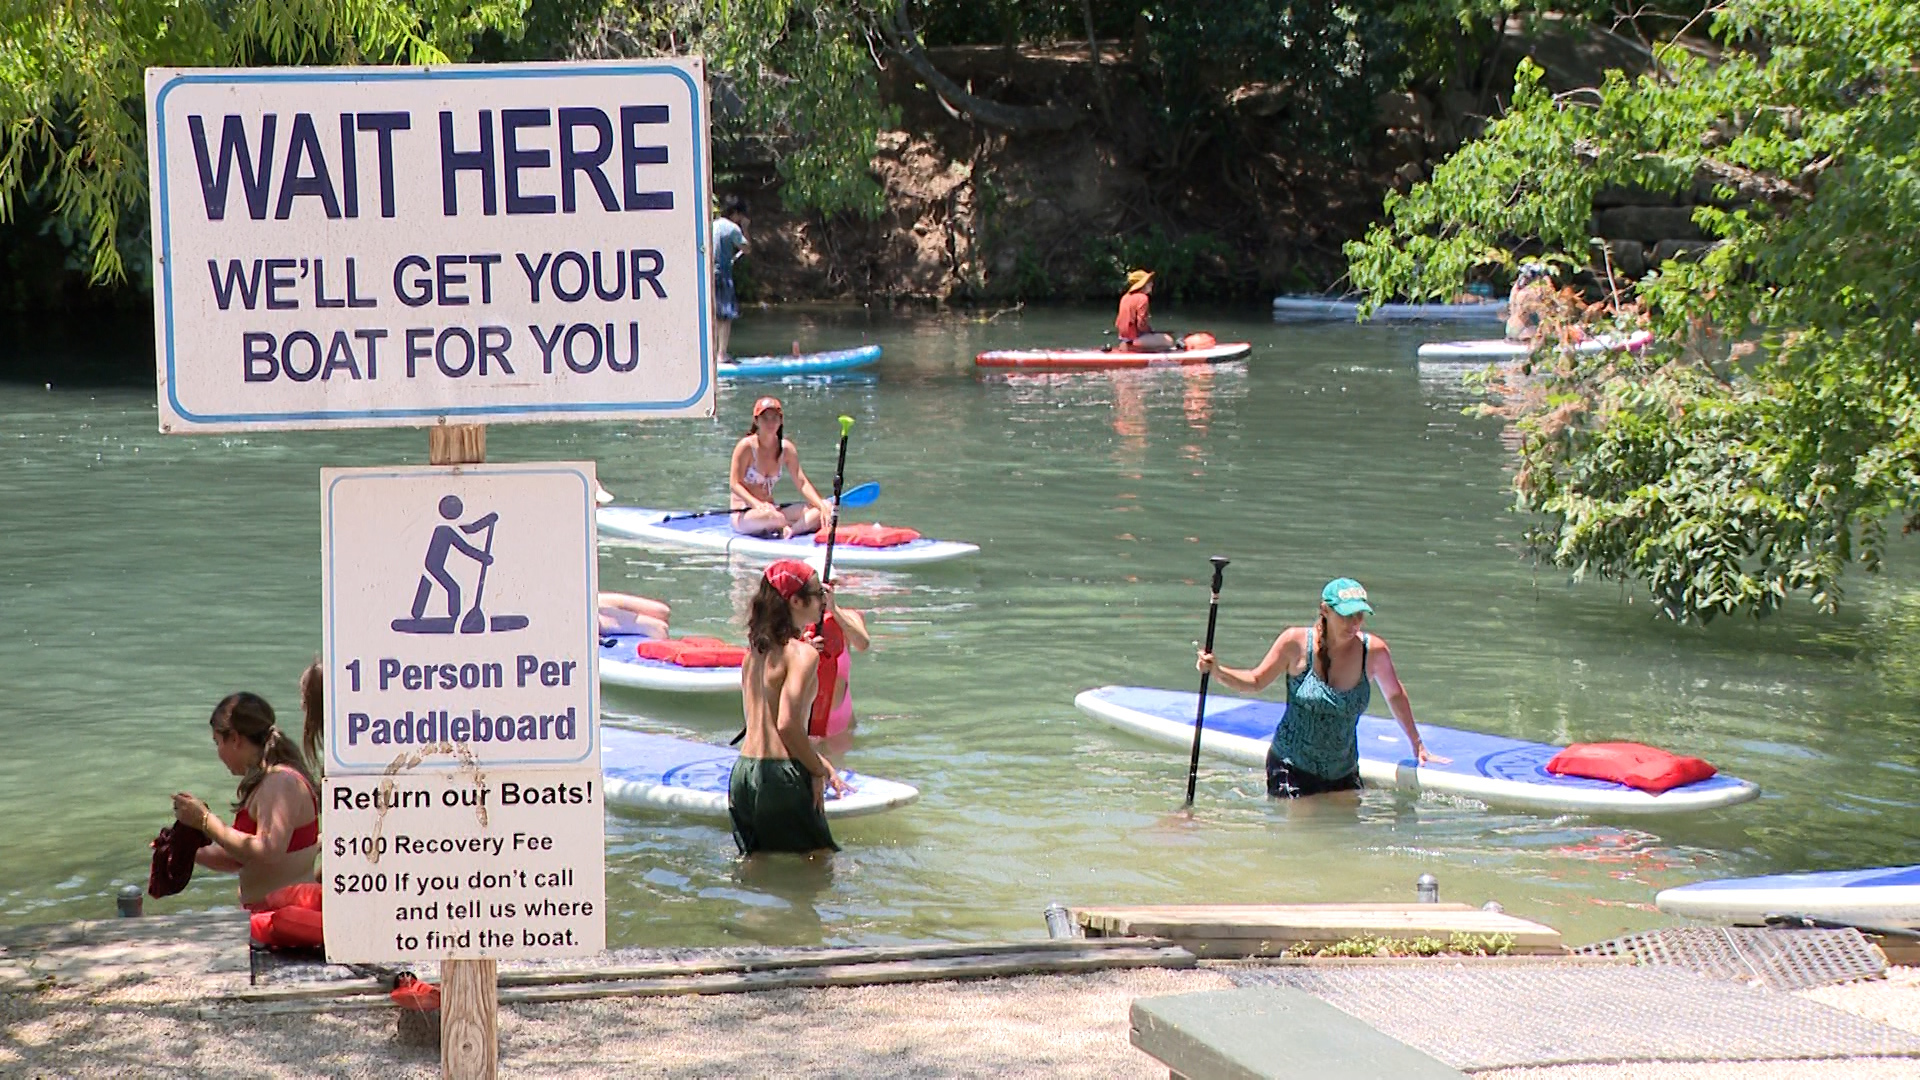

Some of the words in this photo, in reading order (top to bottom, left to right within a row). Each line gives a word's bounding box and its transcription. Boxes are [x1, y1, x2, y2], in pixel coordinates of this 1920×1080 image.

[188, 111, 411, 220] WAIT
[438, 105, 674, 217] HERE
[208, 257, 377, 310] WE'LL
[393, 253, 502, 307] GET
[516, 249, 667, 303] YOUR
[243, 329, 389, 383] BOAT
[406, 325, 514, 378] FOR
[528, 322, 639, 375] YOU
[345, 659, 361, 692] 1
[379, 658, 502, 691] Person
[517, 655, 576, 687] Per
[348, 707, 576, 745] Paddleboard
[333, 787, 430, 809] Return
[442, 787, 491, 807] our
[501, 781, 592, 805] Boats!
[334, 837, 387, 857] $100
[395, 835, 504, 855] Recovery
[513, 833, 553, 850] Fee
[334, 873, 387, 894] $200
[395, 873, 410, 891] If
[417, 874, 459, 895] you
[468, 869, 526, 889] don't
[534, 869, 573, 887] call
[395, 902, 438, 920] and
[447, 900, 480, 918] tell
[490, 902, 516, 917] us
[524, 899, 593, 916] where
[396, 933, 418, 950] to
[426, 930, 470, 948] find
[479, 929, 514, 947] the
[523, 928, 578, 946] boat.
